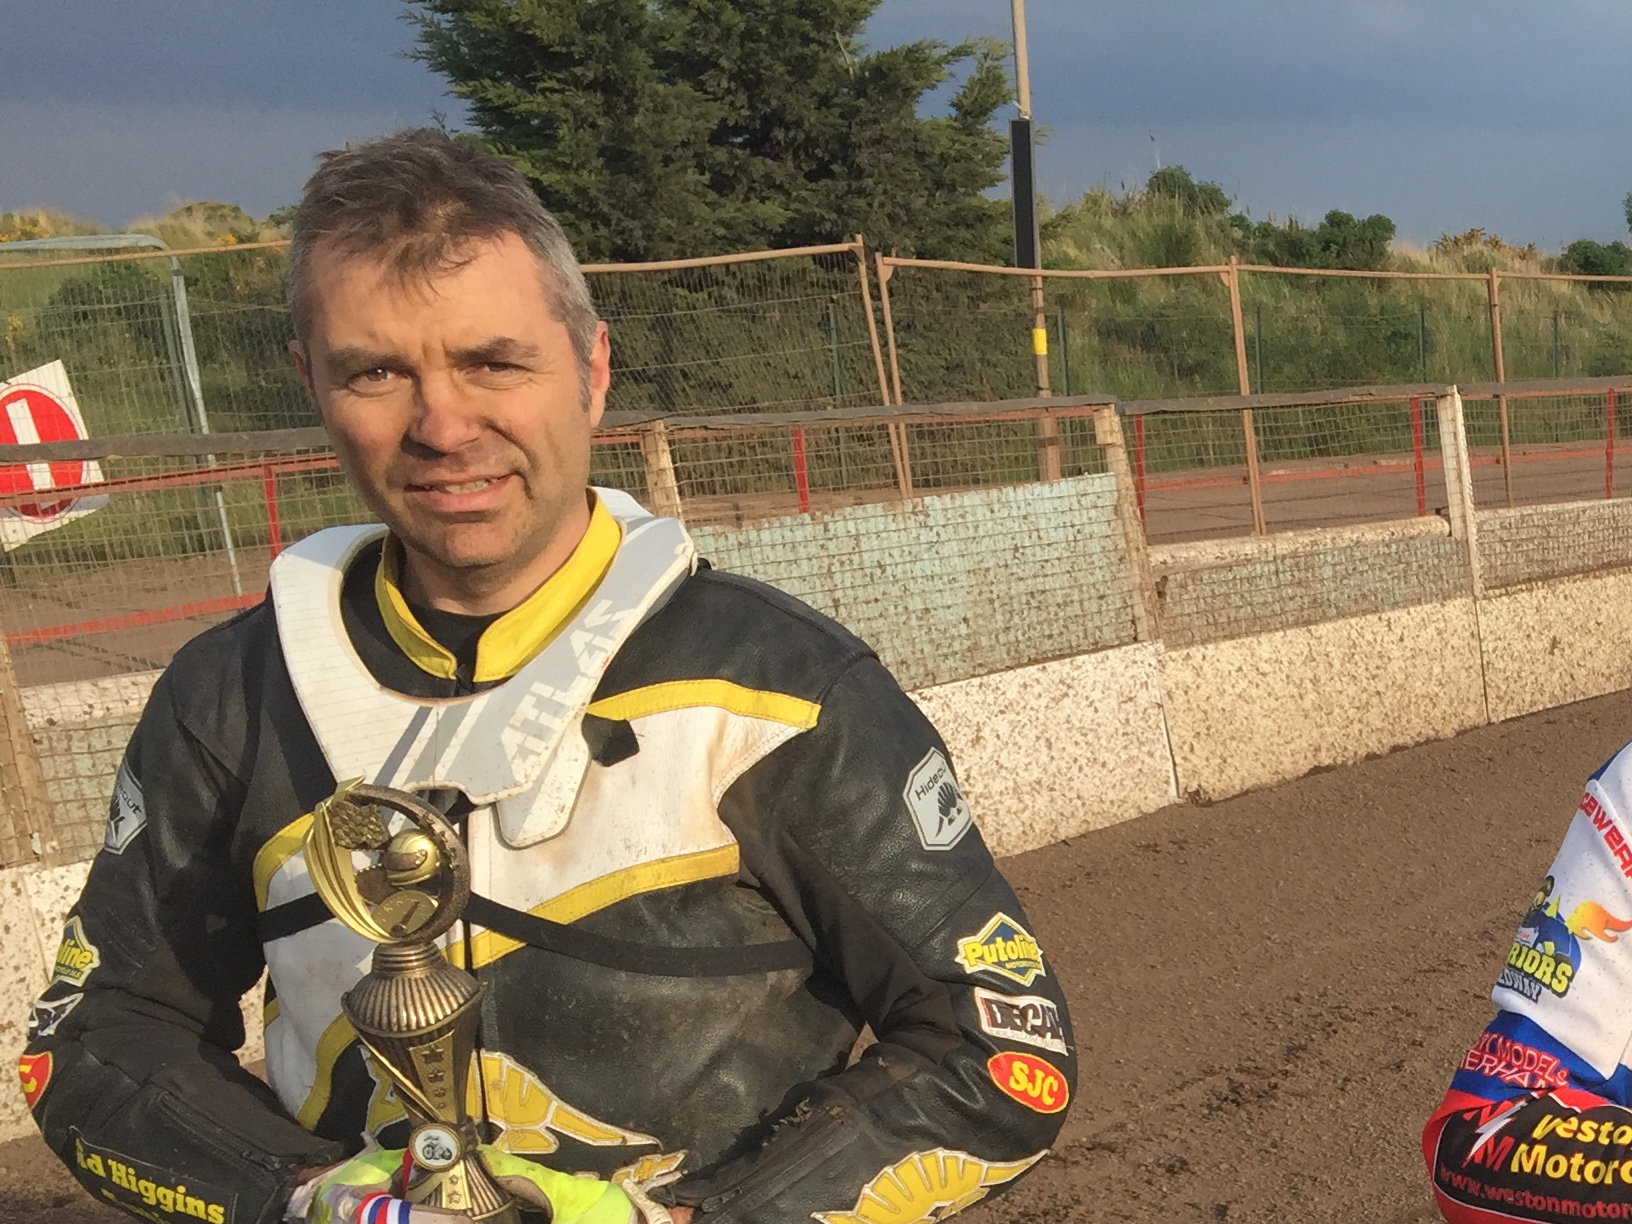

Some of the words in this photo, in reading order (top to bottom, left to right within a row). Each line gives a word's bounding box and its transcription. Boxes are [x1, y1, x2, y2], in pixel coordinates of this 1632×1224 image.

[500, 599, 634, 782] ATLAS
[57, 935, 93, 970] line
[1009, 1061, 1059, 1106] SJC
